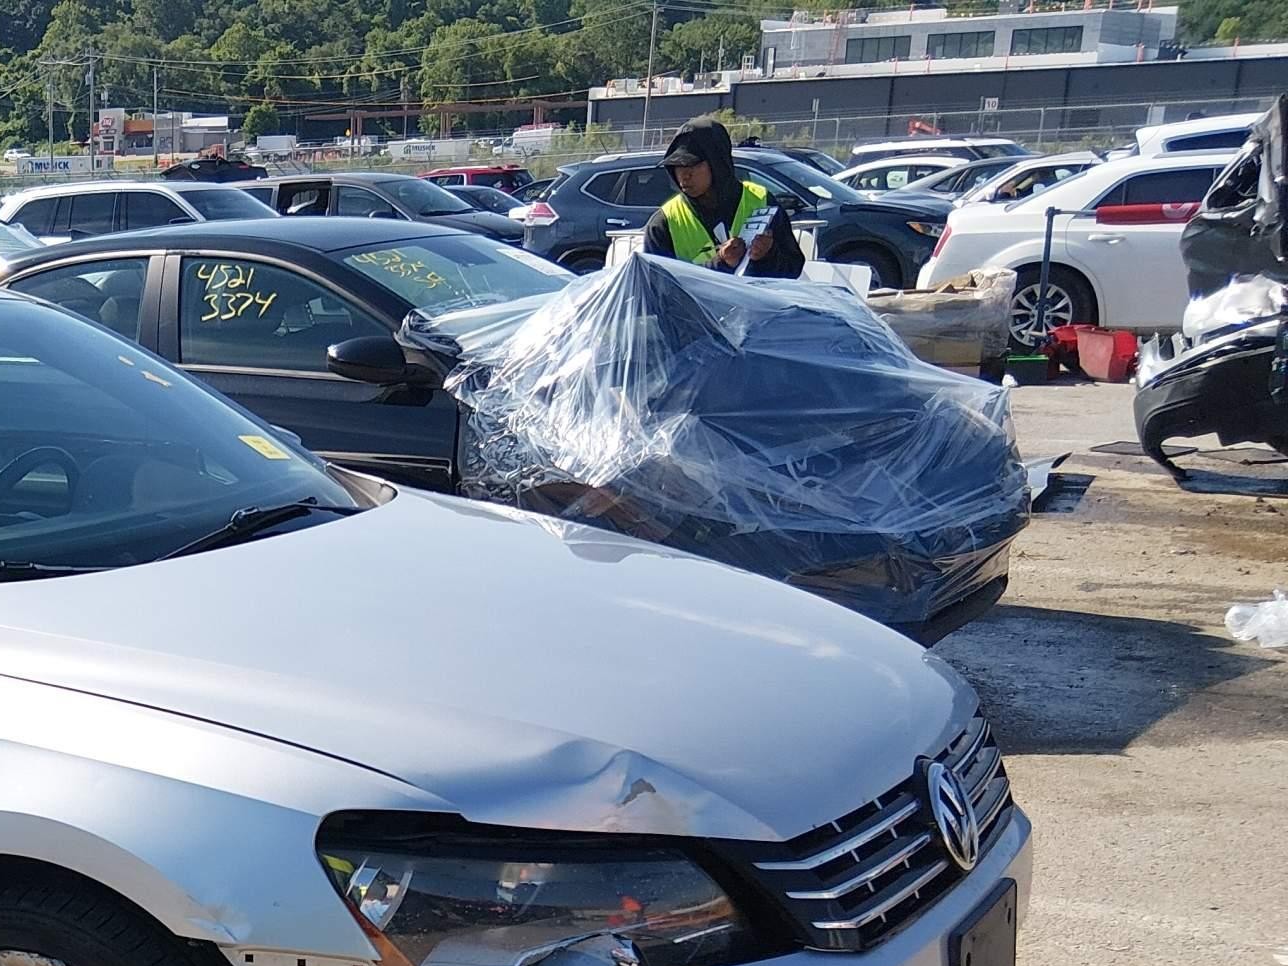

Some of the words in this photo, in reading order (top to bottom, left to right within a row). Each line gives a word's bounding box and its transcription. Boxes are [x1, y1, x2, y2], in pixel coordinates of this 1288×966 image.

[986, 100, 997, 109] 10
[197, 264, 255, 290] 4521
[201, 291, 278, 322] 3374
